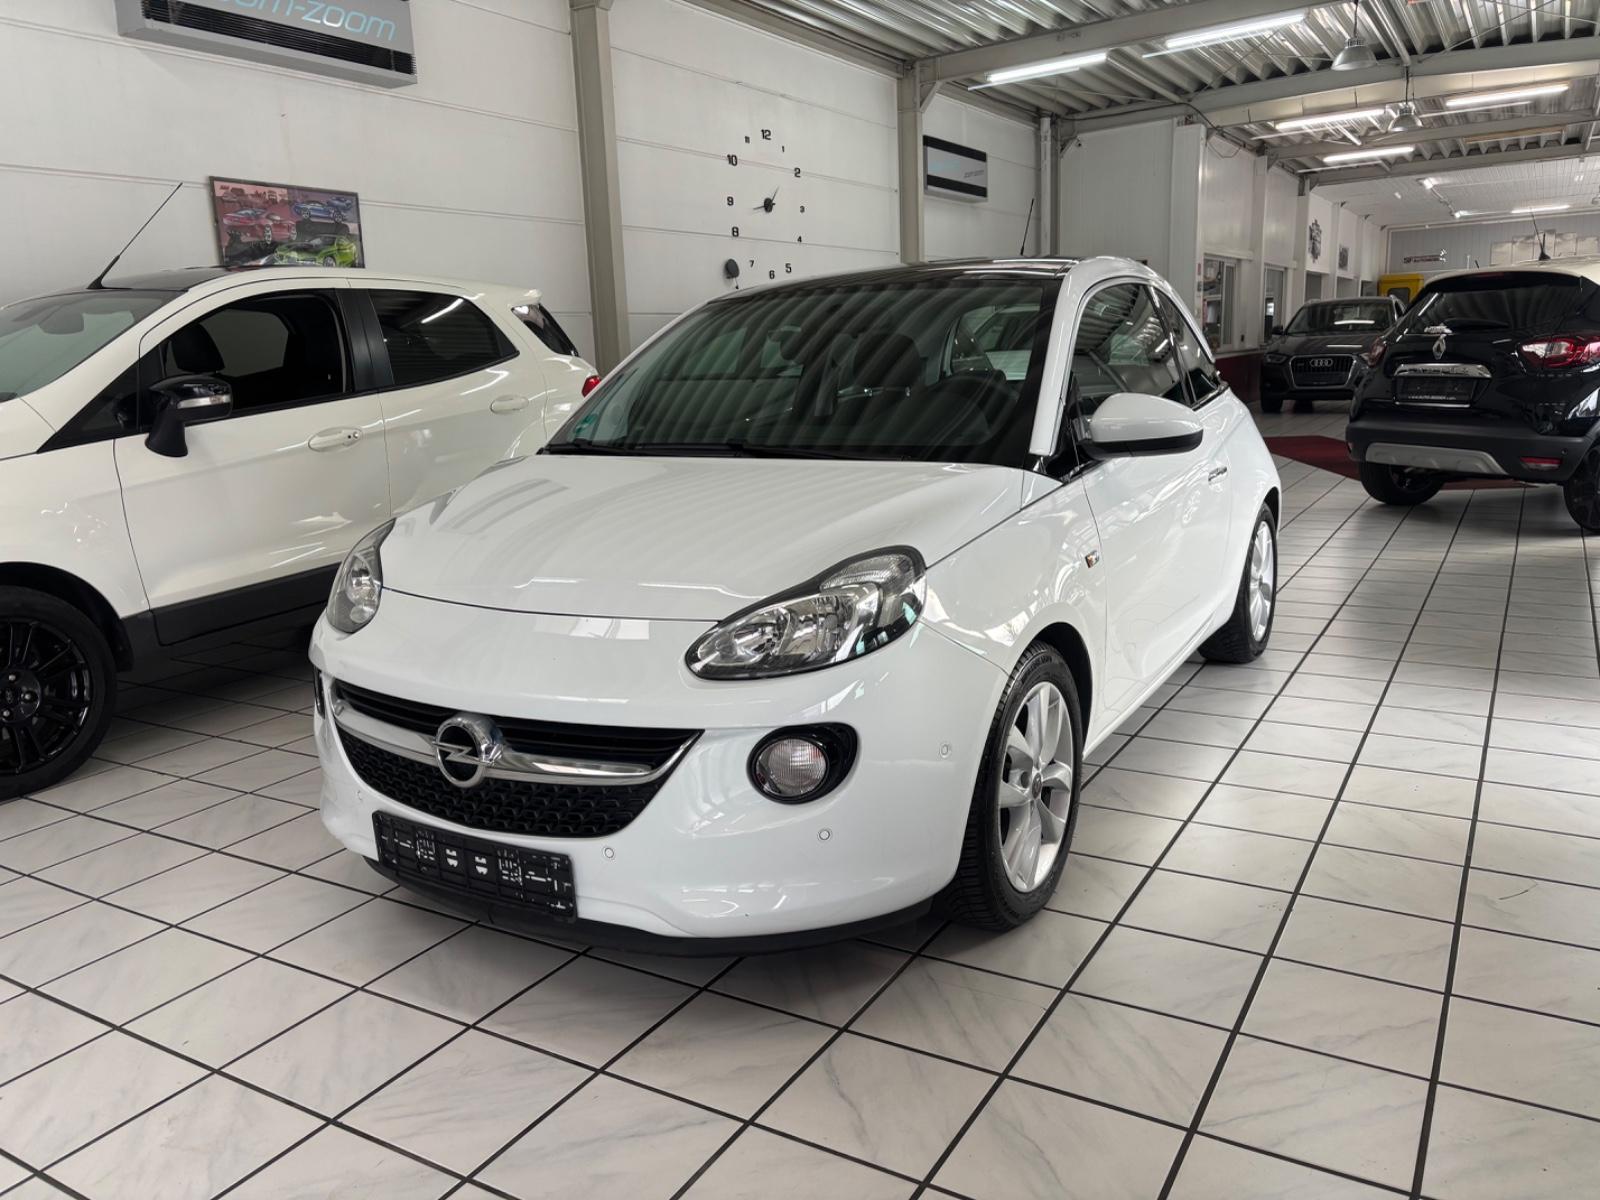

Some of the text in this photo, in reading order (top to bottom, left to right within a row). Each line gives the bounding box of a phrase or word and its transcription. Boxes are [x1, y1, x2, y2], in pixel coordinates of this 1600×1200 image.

[760, 128, 772, 141] 12
[726, 153, 738, 167] 10
[793, 167, 801, 178] 2
[726, 196, 734, 206] 9
[799, 205, 805, 214] 3
[731, 226, 740, 238] 8
[796, 235, 803, 243] 4
[749, 259, 755, 268] 7
[785, 262, 792, 274] 5
[768, 269, 776, 280] 6
